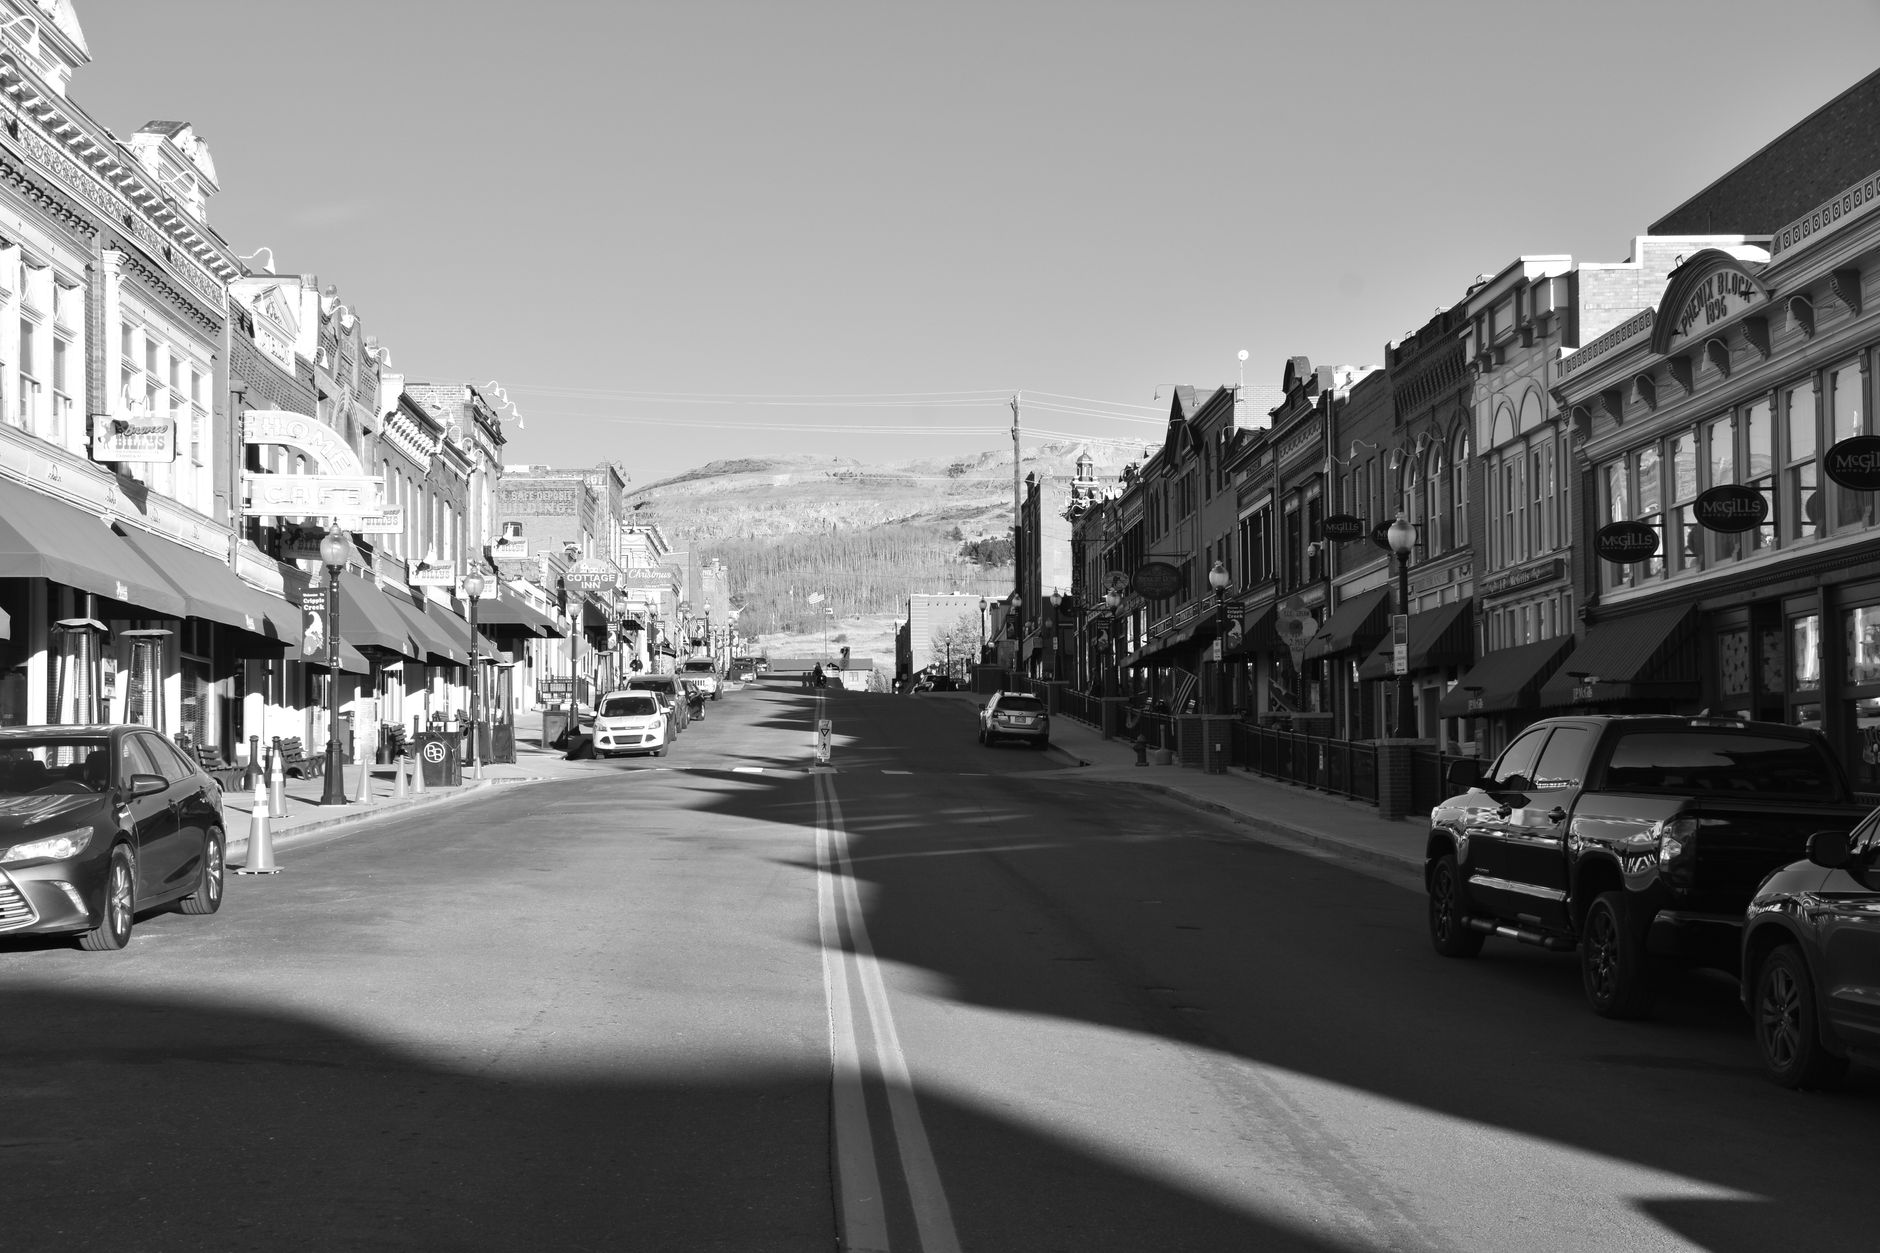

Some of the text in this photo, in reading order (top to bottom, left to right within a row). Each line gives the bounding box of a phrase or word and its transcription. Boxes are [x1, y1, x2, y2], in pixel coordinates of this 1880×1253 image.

[1681, 271, 1753, 337] PHENIX BLOCK
[1705, 295, 1727, 325] 1896
[124, 424, 168, 436] Bronco
[262, 416, 352, 475] HOME
[264, 486, 362, 505] CAFE
[511, 490, 536, 501] SAFE
[566, 574, 616, 582] COTTAGE
[581, 581, 601, 589] INN
[302, 597, 325, 605] Cripple
